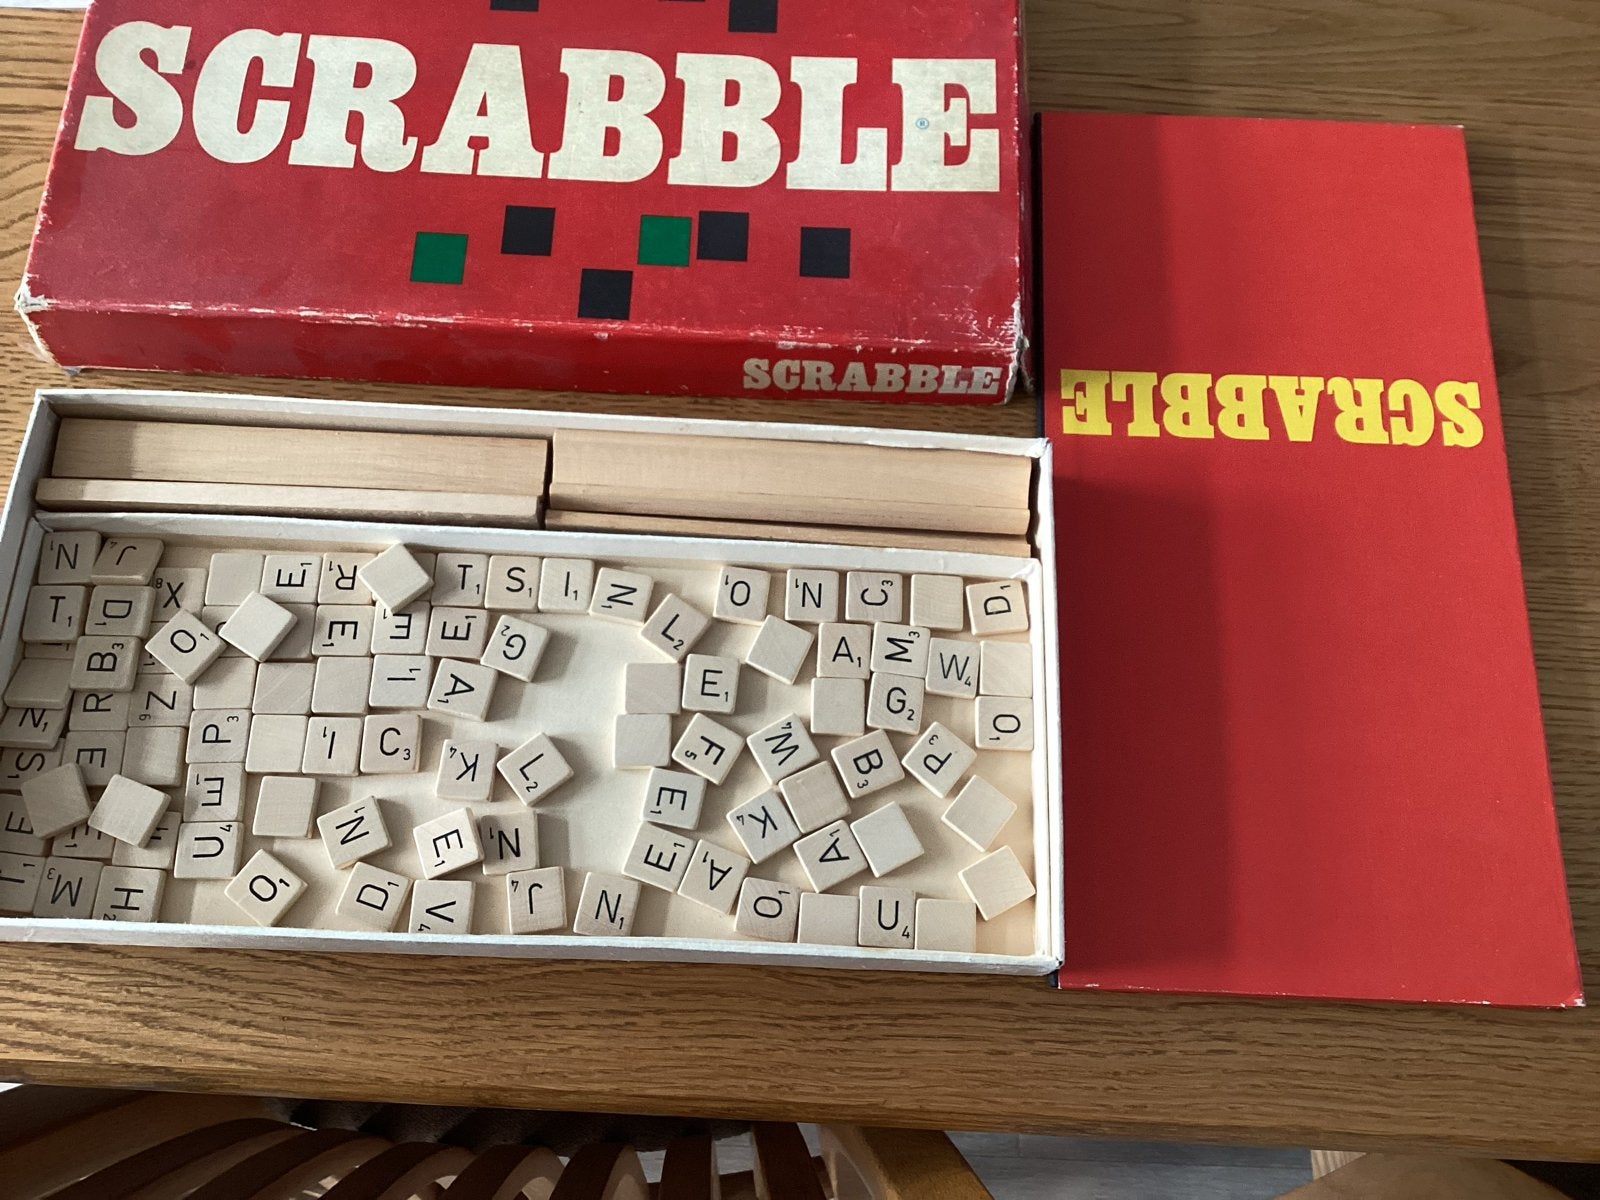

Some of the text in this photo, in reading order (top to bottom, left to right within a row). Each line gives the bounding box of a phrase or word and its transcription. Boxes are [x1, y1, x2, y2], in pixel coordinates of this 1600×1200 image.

[74, 20, 1000, 192] SCRABBLE
[743, 358, 1003, 396] SCRABBLE
[1060, 368, 1484, 448] SCRABBLE
